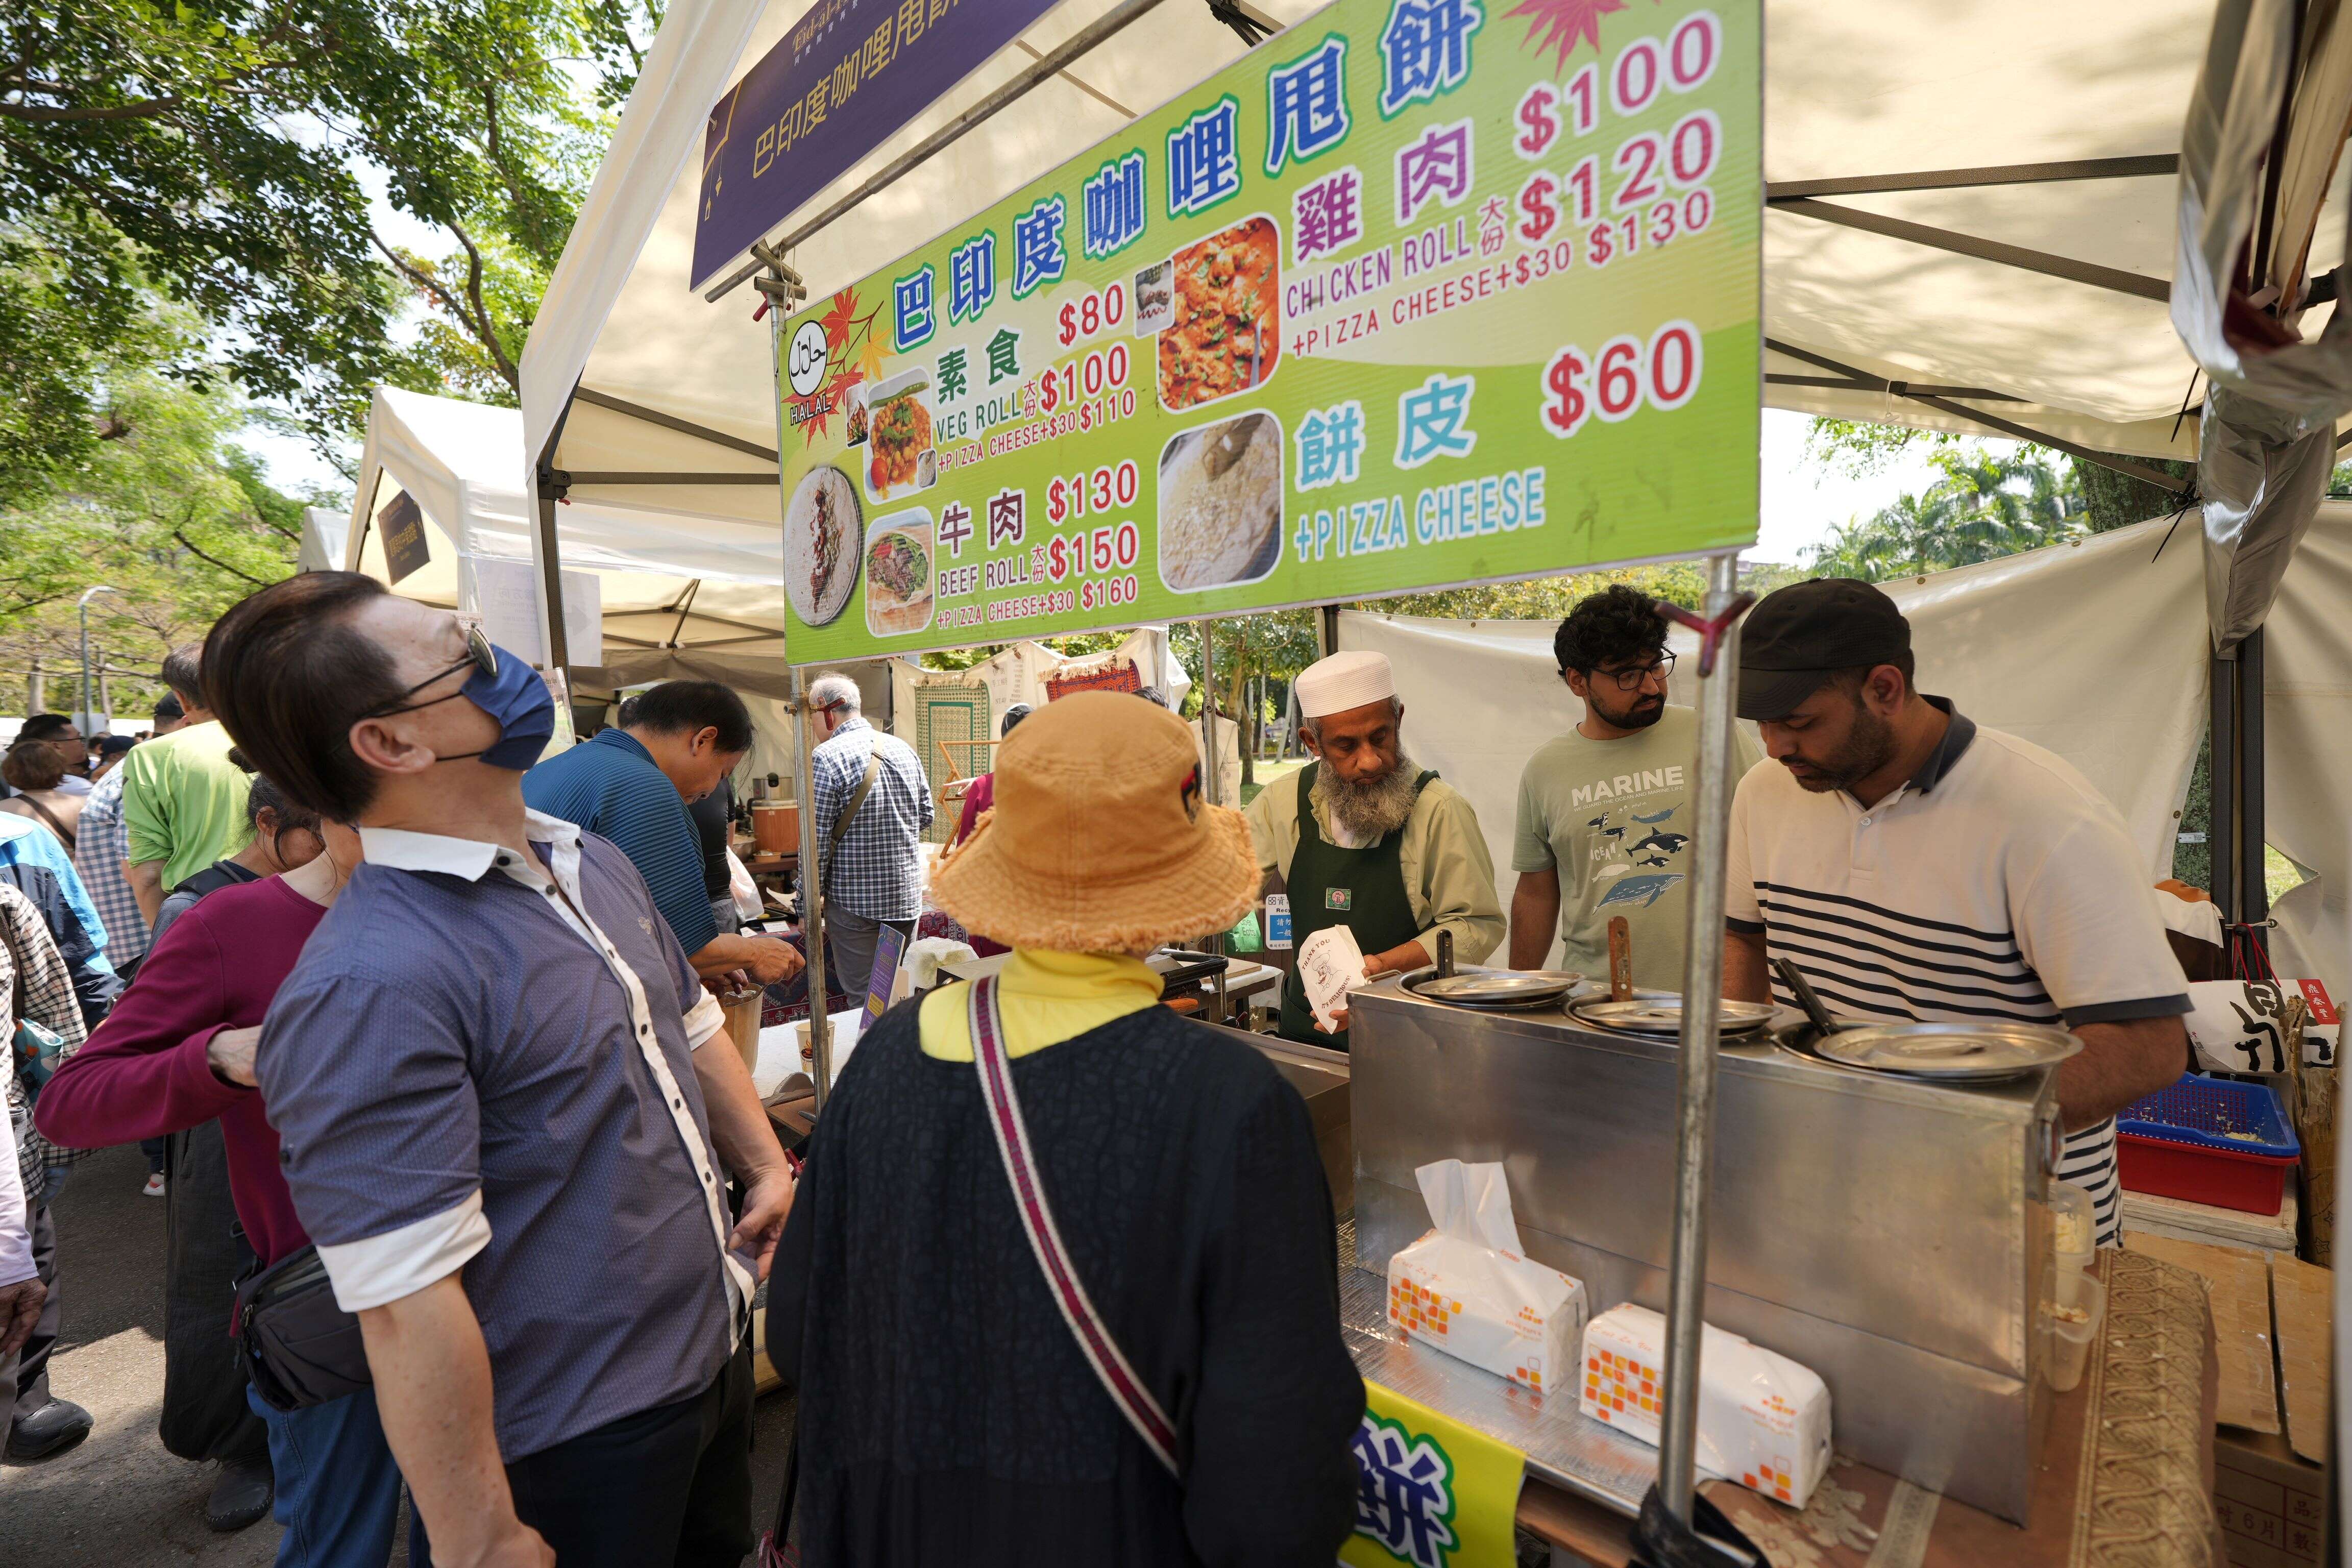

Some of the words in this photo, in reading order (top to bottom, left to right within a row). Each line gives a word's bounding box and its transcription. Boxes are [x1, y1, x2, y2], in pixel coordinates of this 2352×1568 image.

[1298, 125, 1467, 262] 雞肉
[1520, 17, 1714, 154] $100
[1287, 249, 1391, 318] CHICKEN
[1404, 220, 1471, 276] ROLL
[1520, 116, 1714, 241] $120
[1292, 309, 1379, 357] +PIZZA
[1392, 241, 1571, 325] CHEESE+$30
[1588, 190, 1710, 264] $130
[937, 329, 1020, 405] 素食
[1059, 284, 1122, 346] $80
[790, 393, 831, 426] HALAL
[937, 411, 967, 443] VEG
[976, 392, 1021, 430] ROLL
[1041, 346, 1126, 411] $100
[938, 442, 984, 471] +PIZZA
[990, 412, 1075, 457] CHEESE+$30
[1080, 390, 1134, 431] $110
[1300, 381, 1469, 490] 餅皮
[1547, 328, 1694, 430] $60
[939, 492, 1023, 555] 牛肉
[1048, 463, 1136, 523] $130
[1294, 495, 1405, 562] +PIZZA
[1416, 471, 1545, 543] CHEESE
[937, 605, 983, 628] +PIZZA
[988, 591, 1073, 622] CHEESE+$30
[1082, 576, 1136, 609] $160
[939, 567, 977, 598] BEEF
[986, 558, 1028, 589] ROLL
[1049, 525, 1136, 580] $150
[1572, 766, 1684, 806] MARINE
[1583, 801, 1602, 810] GUARD
[1615, 794, 1634, 802] OCEAN
[1648, 787, 1670, 796] MARINE
[1302, 947, 1315, 970] THANK
[1315, 939, 1330, 948] YOU
